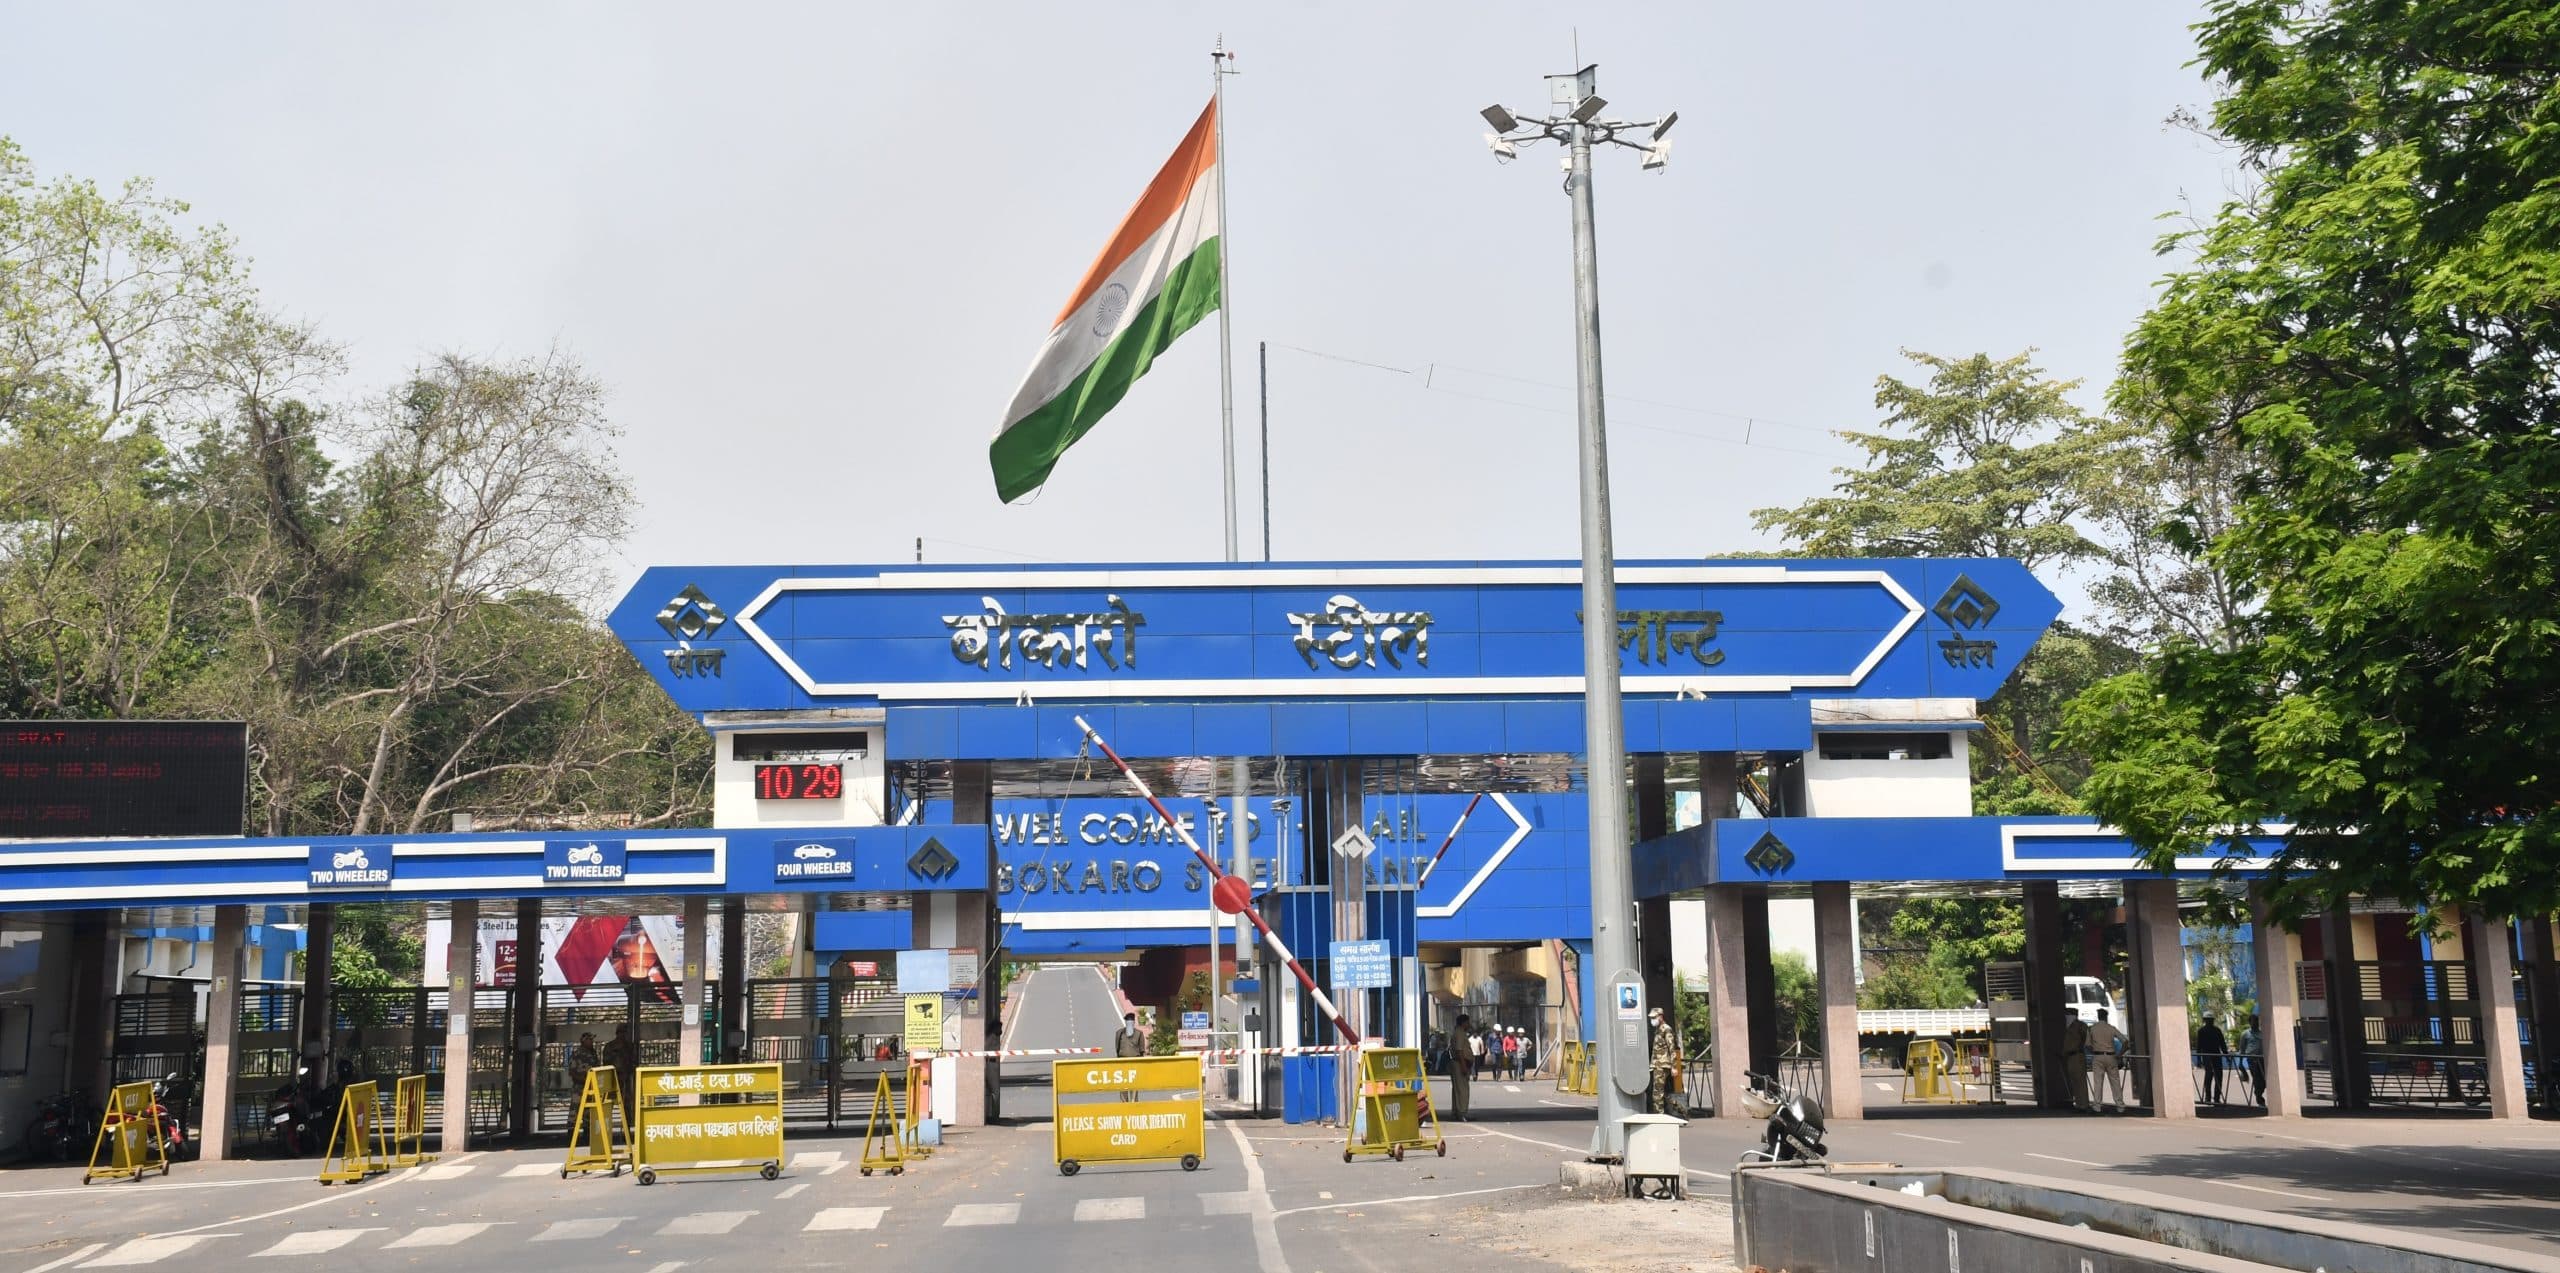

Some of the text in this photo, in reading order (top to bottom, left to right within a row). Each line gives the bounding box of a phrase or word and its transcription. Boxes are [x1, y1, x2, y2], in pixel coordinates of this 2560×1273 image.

[942, 594, 1725, 672] बोकारो स्टील लान्ट
[662, 640, 726, 679] सेल
[1937, 631, 1998, 670] सेल
[757, 765, 840, 799] 10 29
[311, 869, 388, 883] TWO WHEELERS
[547, 865, 622, 878] TWO WHEELERS
[777, 861, 852, 876] FOUR WHEELERS
[998, 860, 1162, 893] BOKARO
[1385, 1103, 1401, 1121] STOP
[1062, 1113, 1187, 1133] PLEASE SHOW YOUR IDENTITY
[1110, 1133, 1137, 1146] CARD
